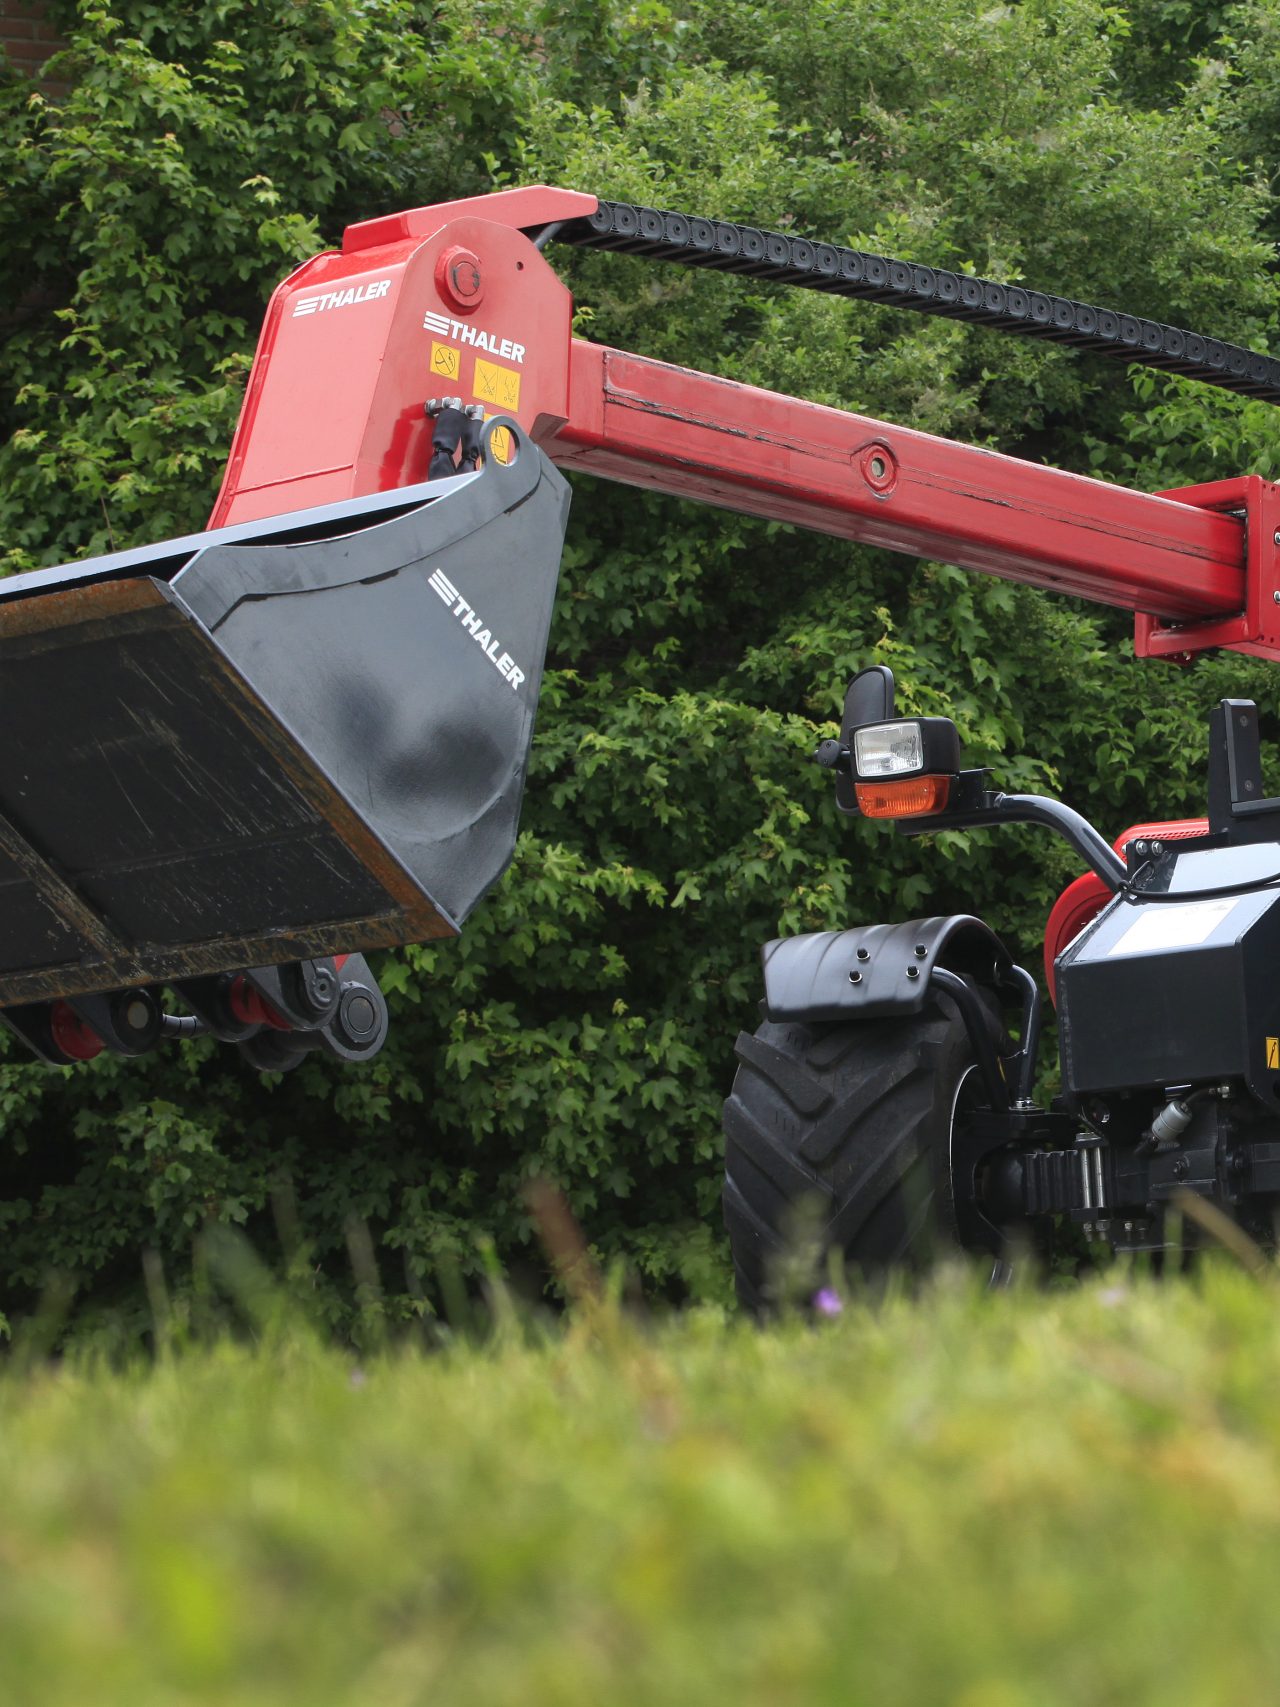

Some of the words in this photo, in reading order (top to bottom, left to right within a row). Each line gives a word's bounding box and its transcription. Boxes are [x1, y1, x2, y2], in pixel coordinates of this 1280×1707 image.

[318, 279, 392, 312] THALER
[450, 319, 526, 364] THALER
[453, 595, 525, 690] THALER
